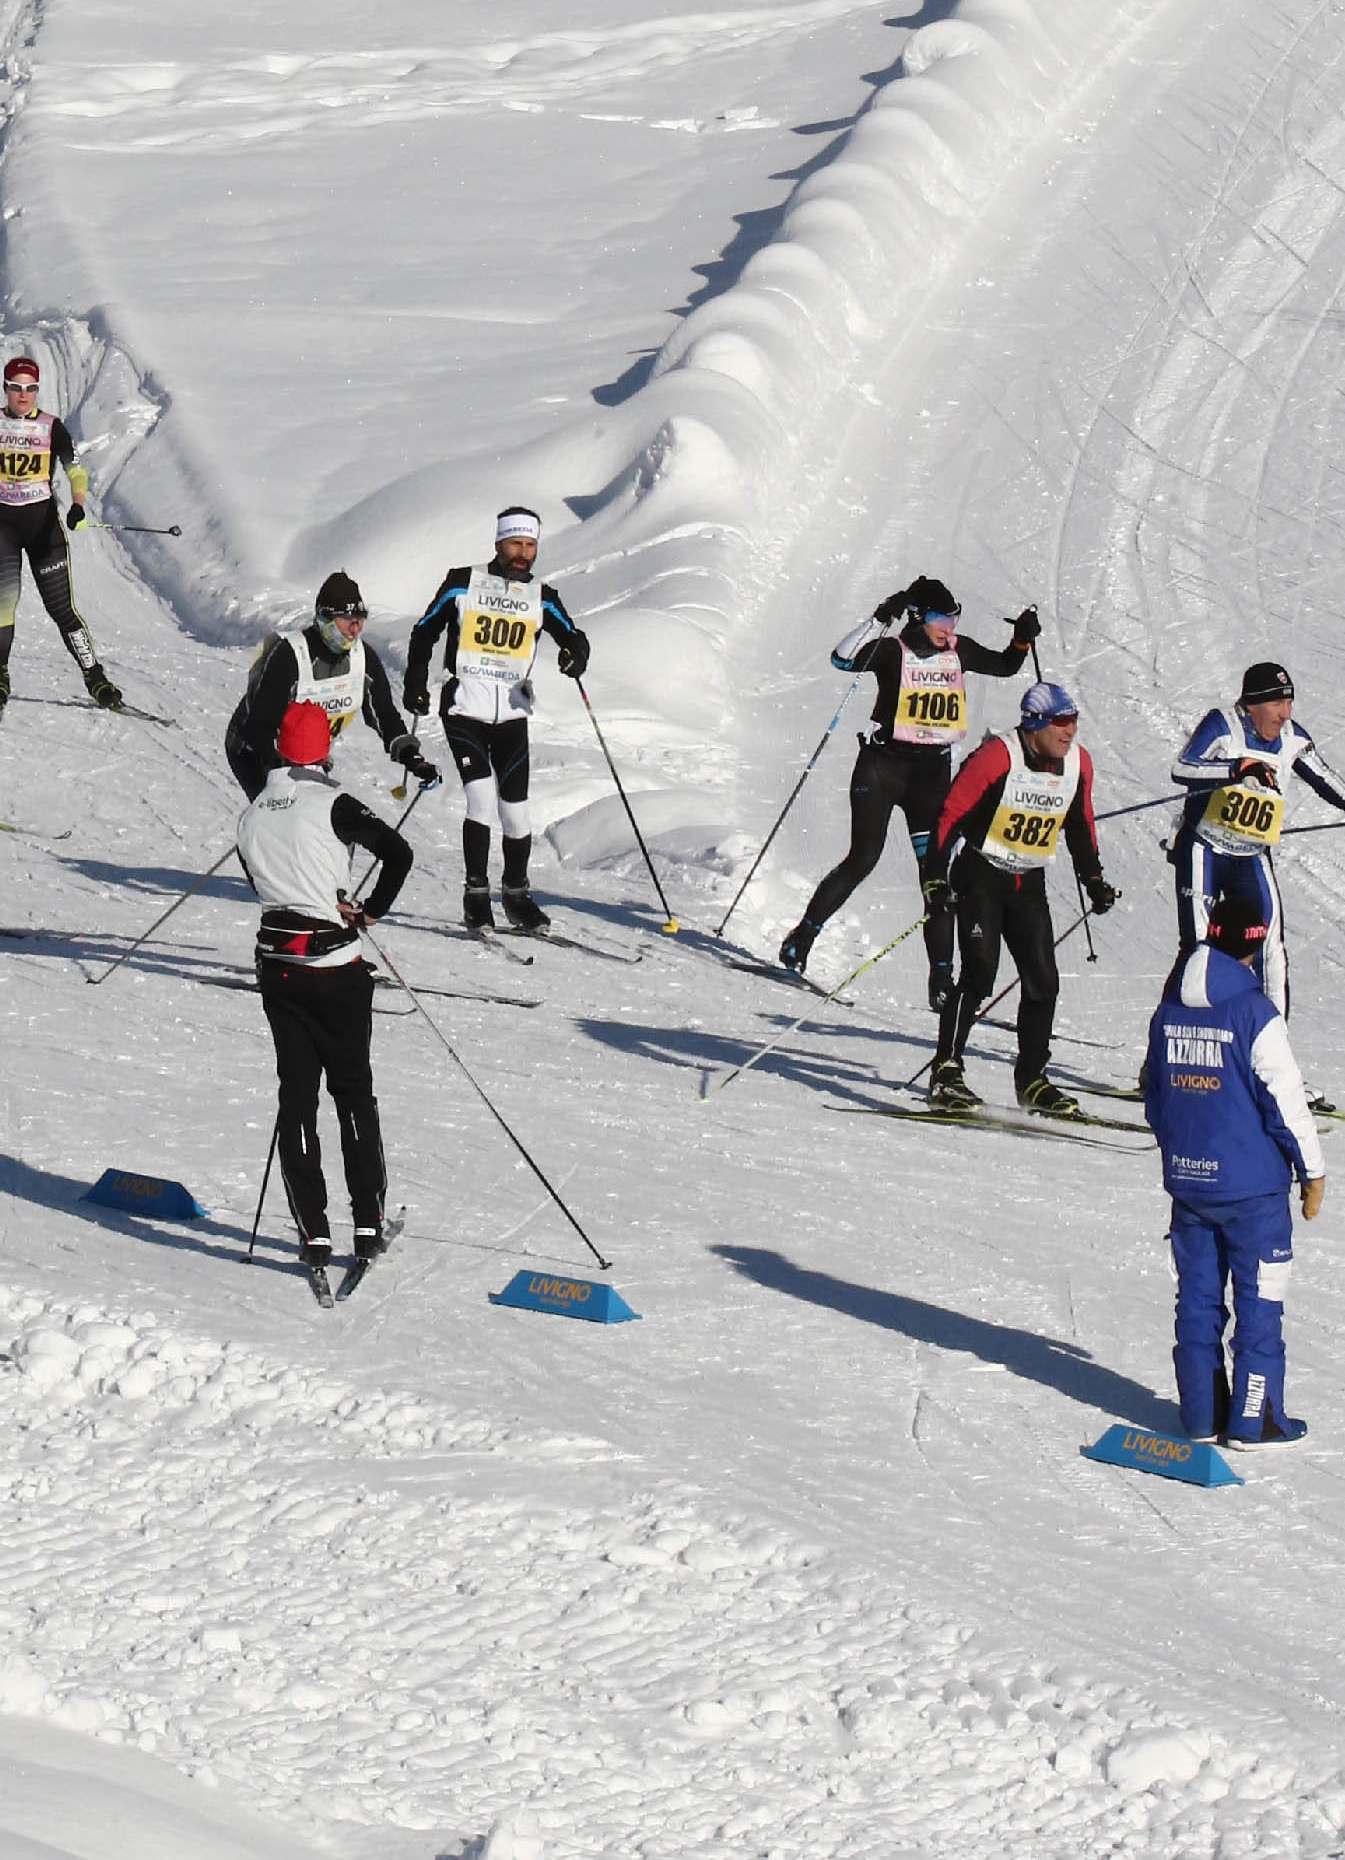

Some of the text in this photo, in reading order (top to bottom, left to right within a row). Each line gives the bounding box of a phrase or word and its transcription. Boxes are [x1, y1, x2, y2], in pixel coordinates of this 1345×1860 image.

[0, 433, 41, 447] LIVIGNO
[478, 595, 530, 612] LIVIGNO
[474, 615, 527, 650] 300
[911, 671, 957, 682] LIVIGNO
[906, 691, 959, 722] 1106
[1015, 790, 1064, 808] LIVIGNO
[1220, 791, 1275, 833] 306
[1003, 813, 1056, 847] 382
[1167, 1038, 1224, 1068] AZZURRA
[1170, 1073, 1222, 1090] LIVIGNO
[528, 1275, 592, 1302] LIVIGNO
[1122, 1430, 1193, 1464] LIVIGNO
